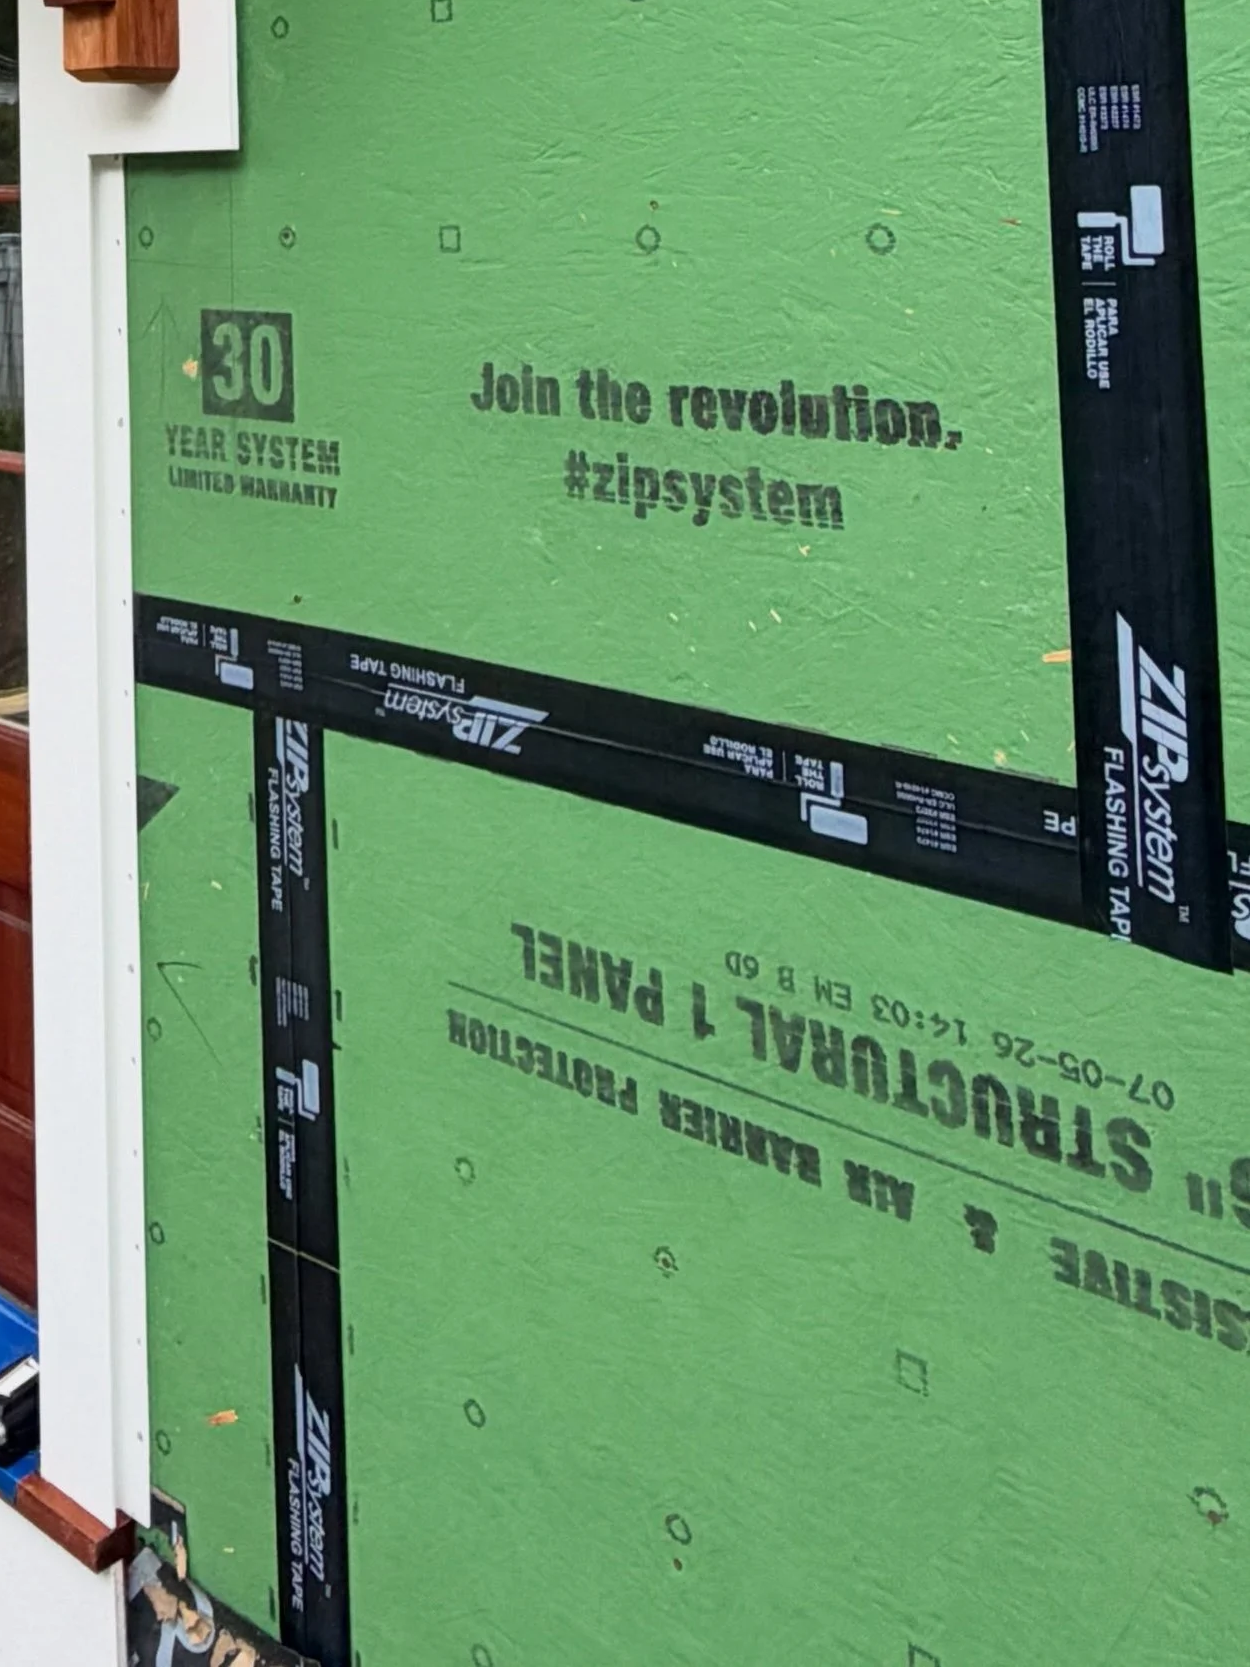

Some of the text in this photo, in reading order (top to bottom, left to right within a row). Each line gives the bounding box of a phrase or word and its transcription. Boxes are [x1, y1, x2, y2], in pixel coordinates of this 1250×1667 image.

[1081, 235, 1093, 271] TAPE
[1092, 236, 1104, 264] THE
[1103, 235, 1115, 271] ROLL
[1083, 297, 1098, 380] EL RODILLO
[1095, 297, 1111, 389] APLICAR USE
[1106, 297, 1119, 336] PARA
[211, 321, 284, 407] 30
[470, 361, 963, 451] Join the revolution.
[165, 423, 341, 476] YEAR SYSTEM
[168, 465, 235, 495] LIMITED
[563, 448, 845, 530] #zipsystem
[350, 653, 466, 694] FLASHING TAPE
[384, 689, 531, 755] ZIPsystem
[1102, 745, 1129, 879] FLASHING
[1138, 644, 1190, 904] ZIPsystem
[268, 767, 283, 912] FLASHING TAPE
[510, 921, 665, 1027] PANEL
[691, 982, 716, 1039] 1
[777, 965, 795, 993] B
[814, 978, 852, 1011] EM
[871, 991, 967, 1047] 14:03
[447, 1007, 639, 1115] PROTECTION
[736, 995, 1152, 1193] STRUCTURAL
[992, 1031, 1175, 1112] 07-05-26
[659, 1089, 823, 1186] BARRIER
[843, 1159, 916, 1222] AIR
[287, 1457, 304, 1613] FLASHING TAPE
